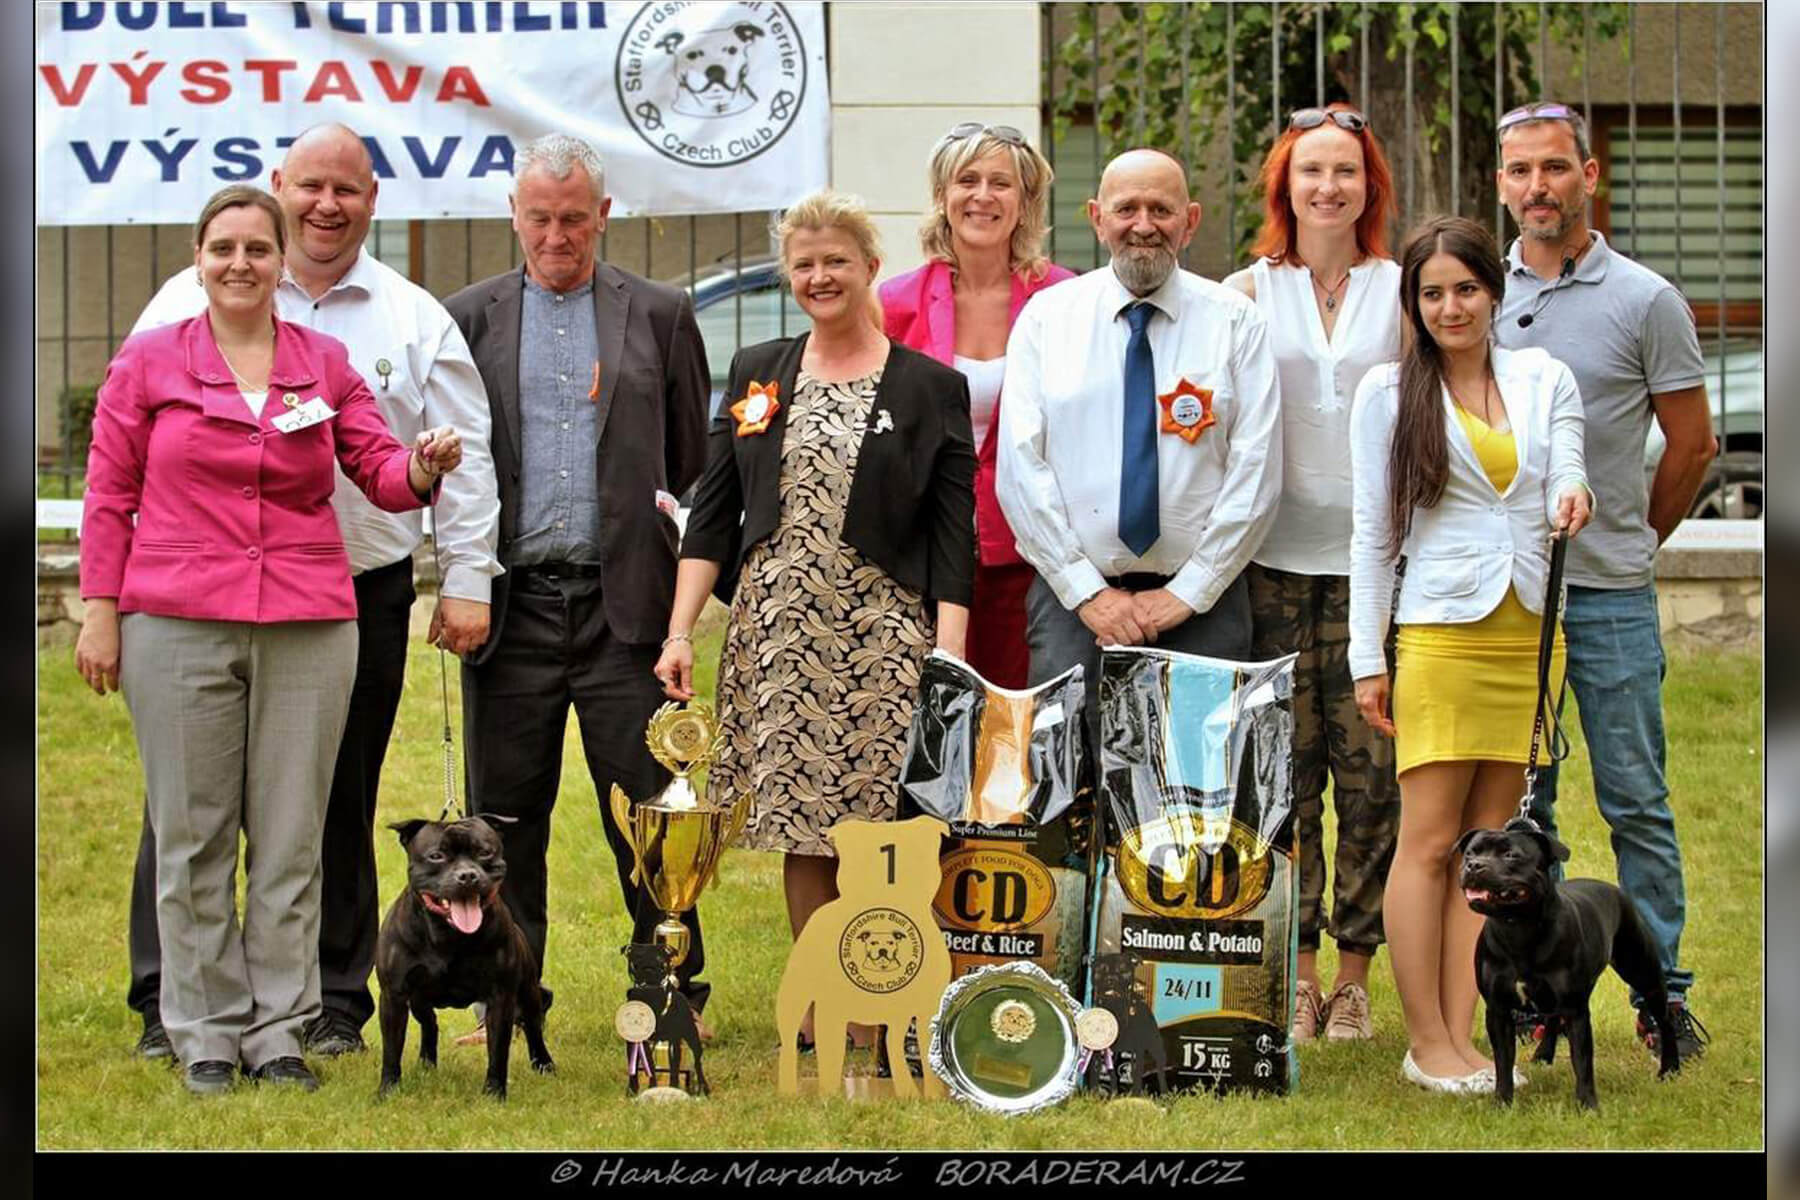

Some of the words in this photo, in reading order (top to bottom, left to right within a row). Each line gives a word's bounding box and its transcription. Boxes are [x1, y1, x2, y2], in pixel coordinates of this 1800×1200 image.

[764, 7, 798, 80] Terrier
[38, 50, 492, 107] VÝSTAVA
[661, 132, 723, 161] Czech
[727, 126, 774, 158] Club
[880, 843, 896, 885] 1
[1146, 842, 1240, 910] CD
[952, 868, 1028, 923] CD
[888, 912, 908, 928] Bull
[944, 931, 980, 952] Beef
[981, 934, 994, 954] &
[998, 934, 1036, 955] Rice
[1122, 926, 1185, 951] Salmon
[1189, 931, 1204, 952] &
[1208, 931, 1262, 954] Potato
[856, 975, 884, 990] Czech
[886, 975, 907, 990] Club
[1164, 978, 1212, 1000] 24/11
[1183, 1042, 1208, 1070] 15
[1210, 1053, 1231, 1069] KG
